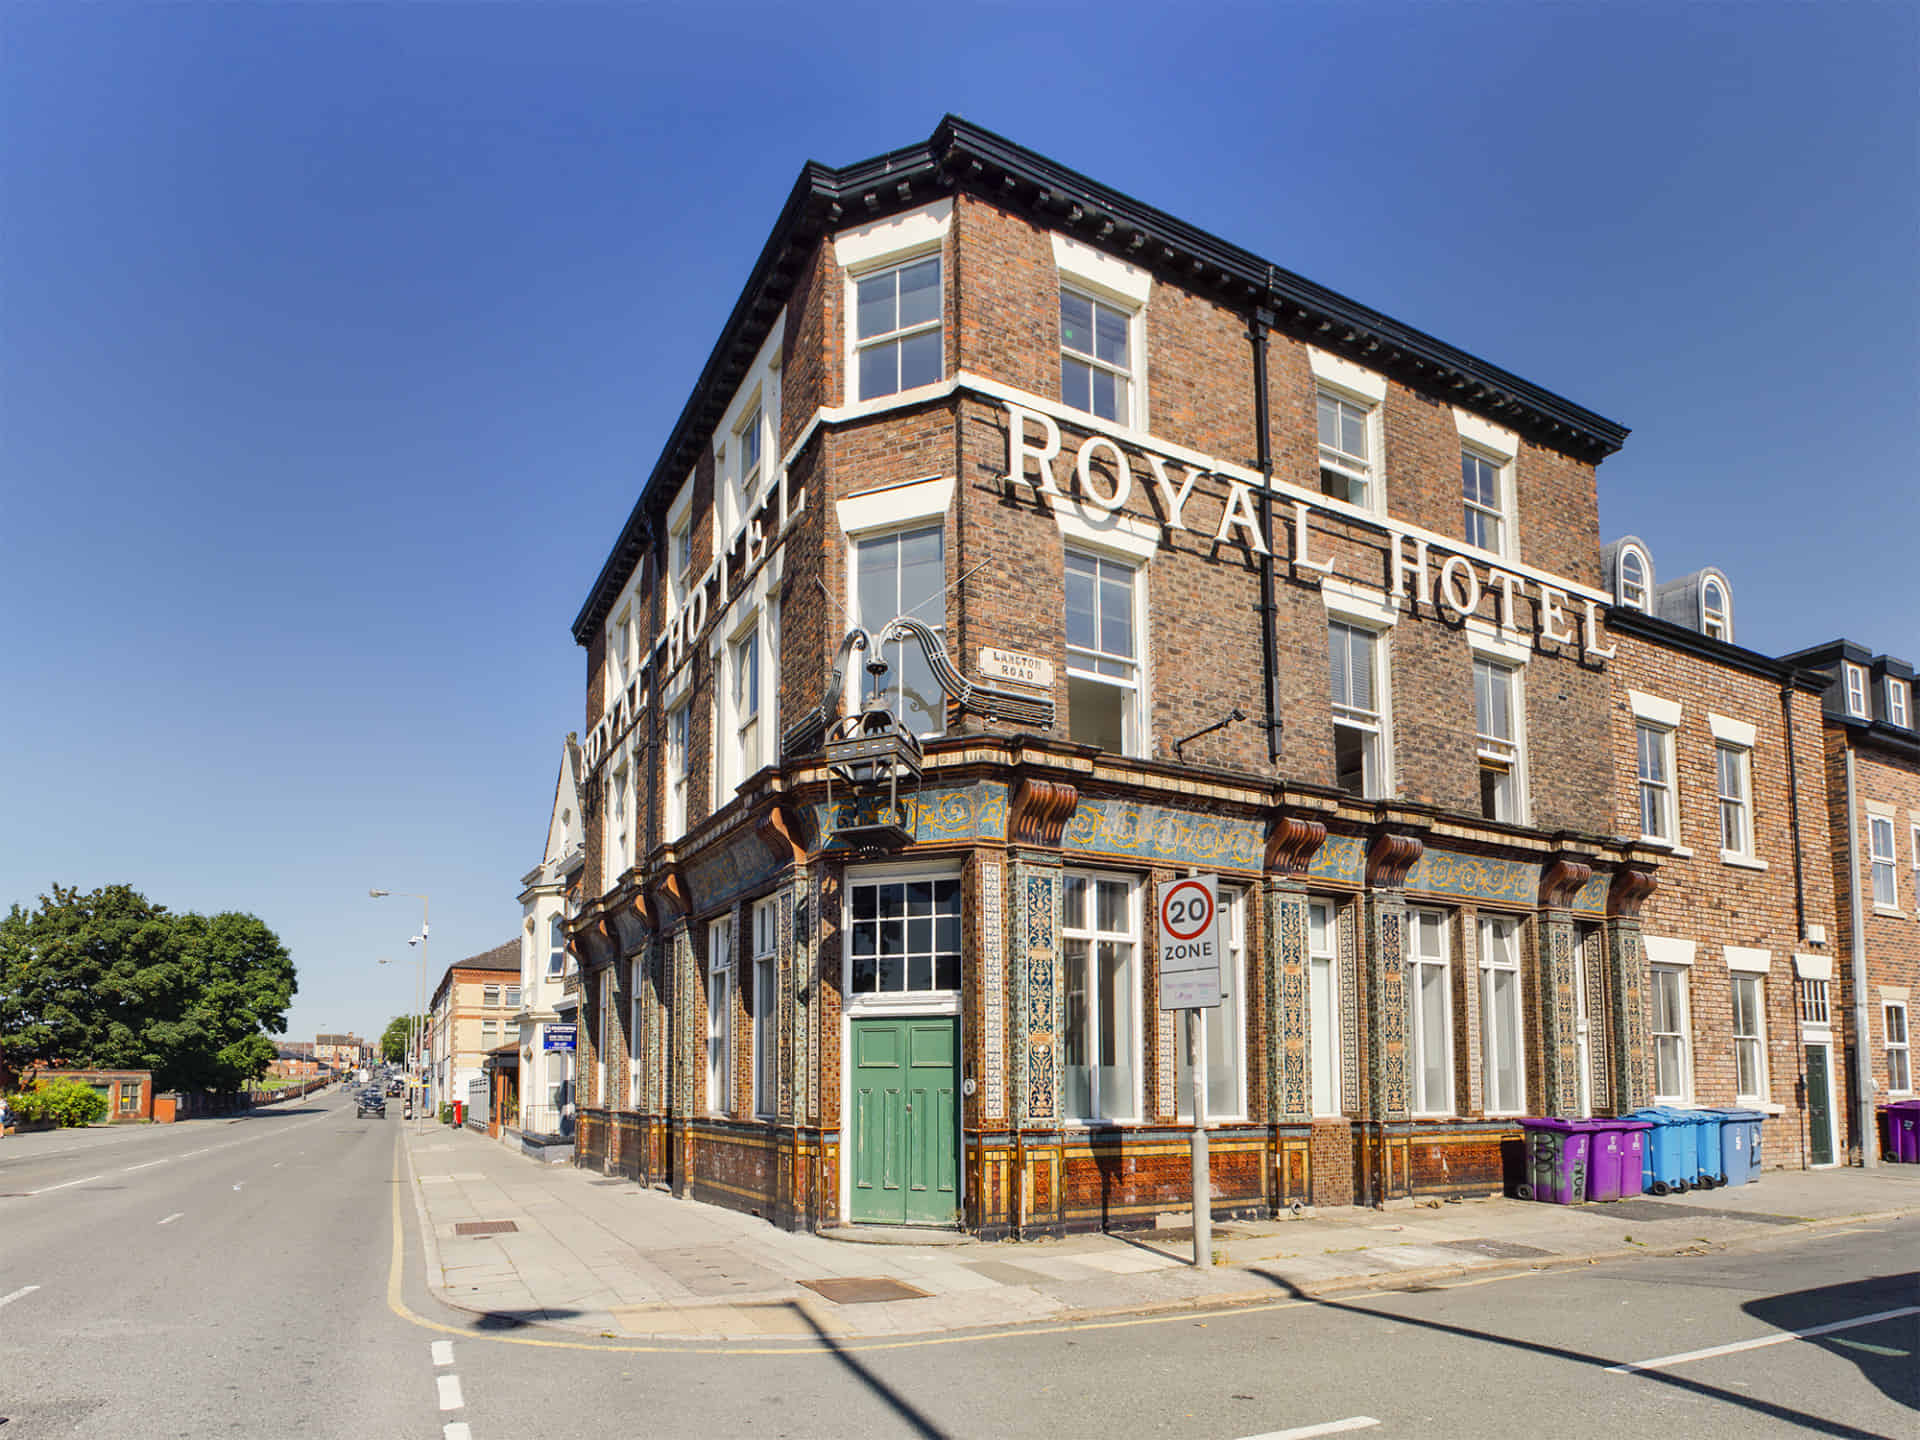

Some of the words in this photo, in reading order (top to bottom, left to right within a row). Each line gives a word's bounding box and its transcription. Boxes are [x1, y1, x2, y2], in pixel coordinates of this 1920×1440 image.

[1003, 402, 1335, 573] ROYAL
[1387, 531, 1617, 659] HOTEL
[580, 670, 648, 785] ROYAL
[667, 468, 807, 677] HOTEL
[1001, 665, 1034, 680] ROAD
[1169, 897, 1206, 924] 20
[1164, 942, 1213, 961] ZONE
